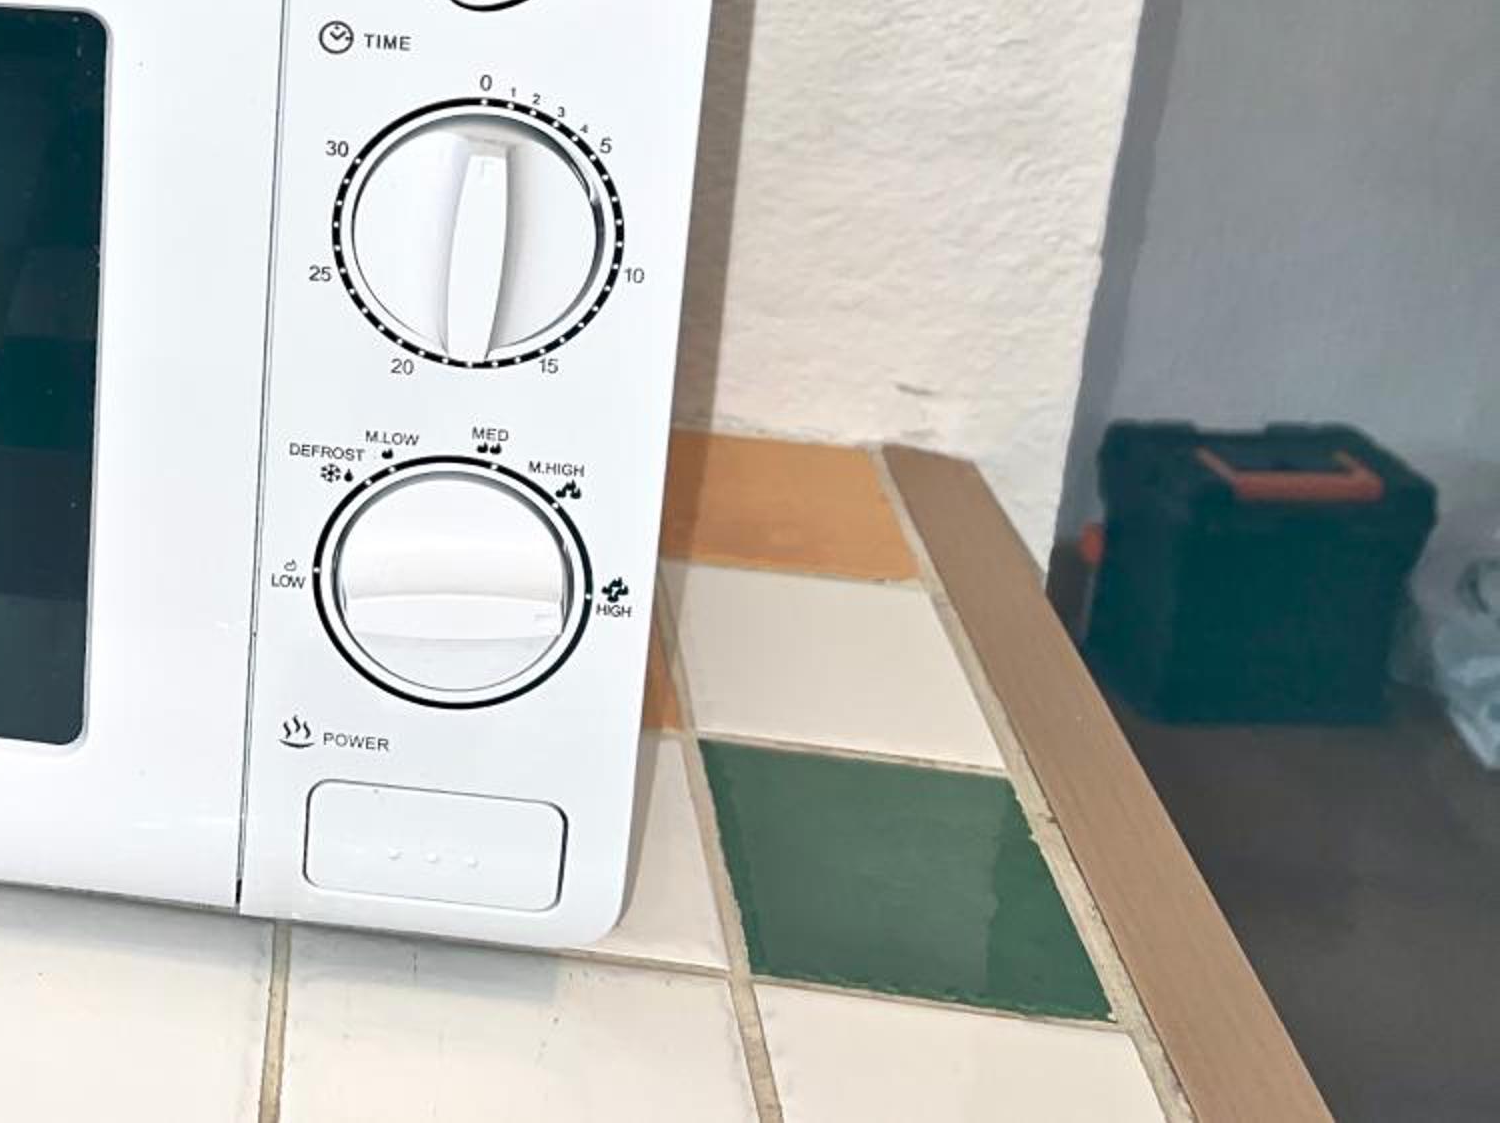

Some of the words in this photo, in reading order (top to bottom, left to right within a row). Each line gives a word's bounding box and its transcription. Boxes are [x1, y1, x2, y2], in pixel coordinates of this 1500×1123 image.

[363, 33, 411, 51] TIME
[479, 74, 492, 91] 0
[510, 87, 516, 97] 1
[532, 93, 541, 105] 2
[557, 107, 565, 118] 3
[580, 123, 589, 134] 4
[325, 140, 349, 158] 30
[599, 137, 612, 154] 5
[308, 265, 332, 281] 25
[625, 267, 645, 284] 10
[390, 358, 414, 375] 20
[539, 358, 560, 374] 15
[365, 429, 420, 446] M.LOW
[472, 427, 509, 442] MED
[289, 442, 365, 462] DEFROST
[528, 460, 585, 478] M.HIGH
[271, 573, 306, 590] LOW
[595, 603, 632, 619] HIGH
[323, 731, 390, 752] POWER
